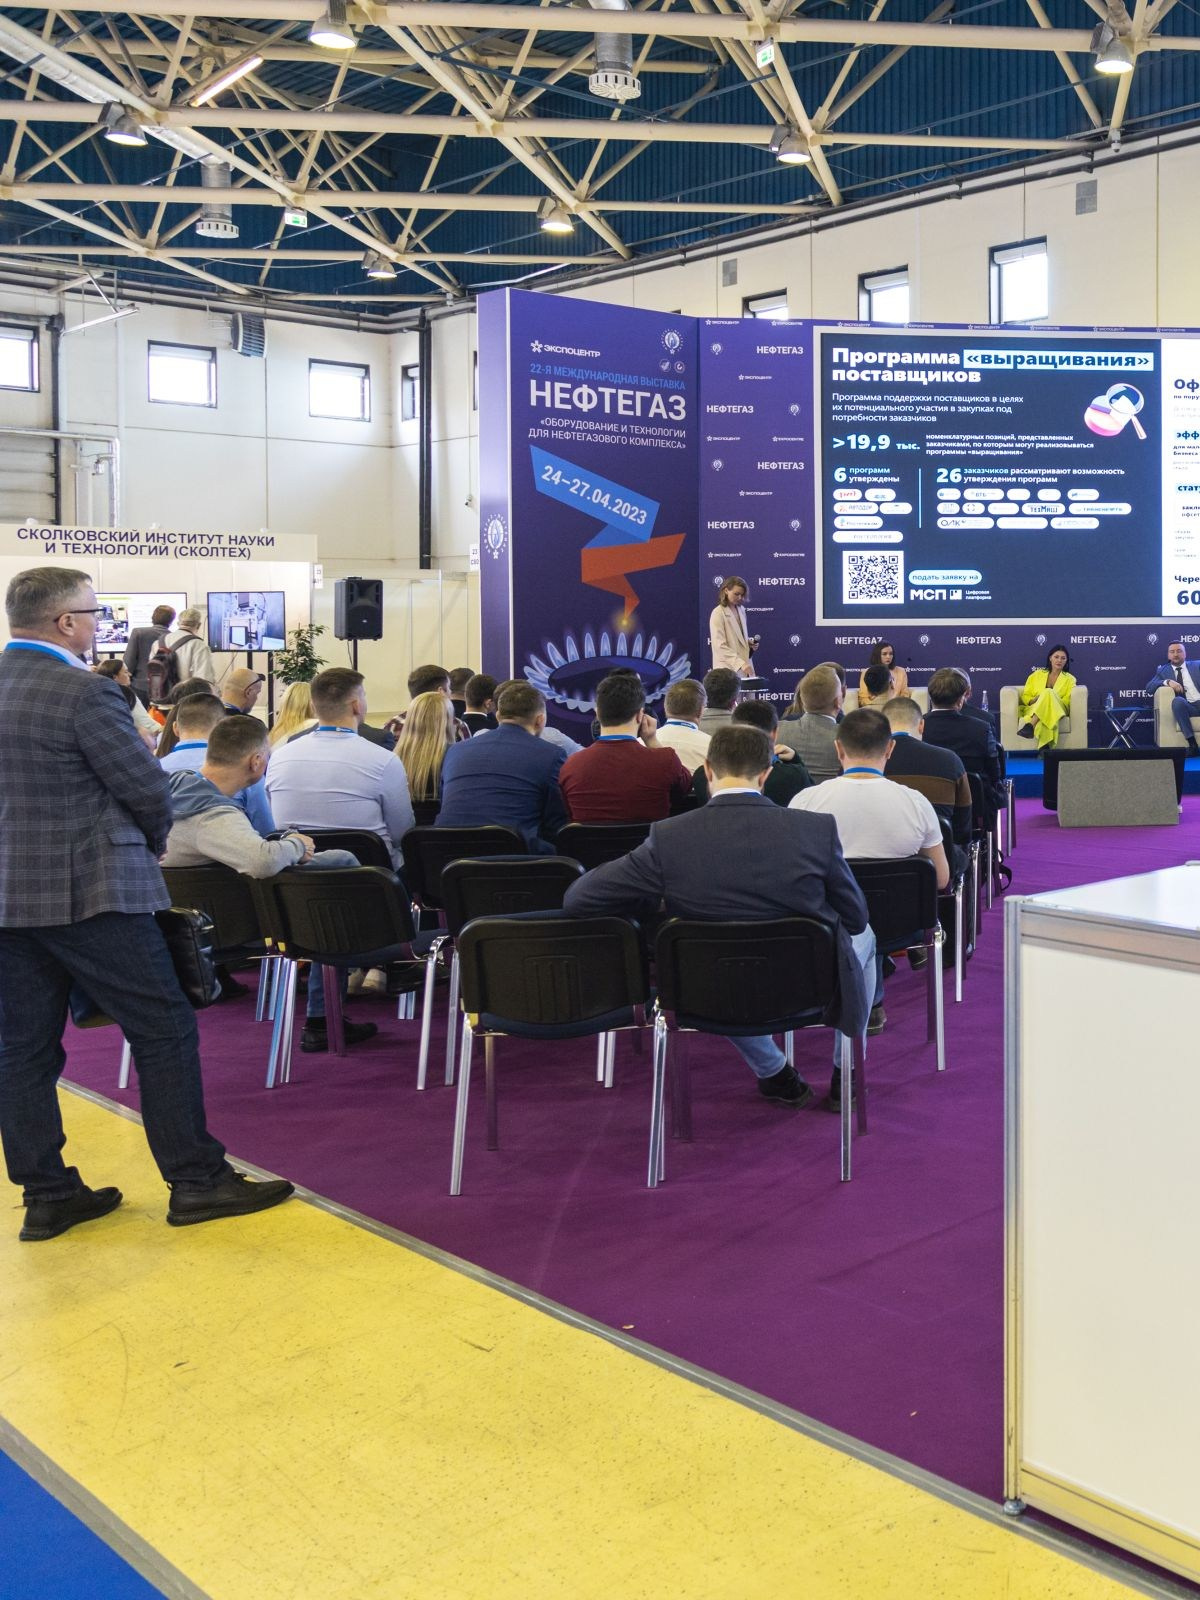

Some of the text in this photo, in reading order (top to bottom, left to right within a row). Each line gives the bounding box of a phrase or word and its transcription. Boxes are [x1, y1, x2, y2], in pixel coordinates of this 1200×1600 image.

[544, 344, 601, 358] ЭКСПОЦЕНТР
[757, 346, 804, 355] НЕФТЕГАЗ
[832, 348, 1149, 370] Программа «выращивания»
[530, 363, 686, 390] 22-Я МЕЖДУНАРОДНАЯ ВЫСТАВКА
[832, 369, 982, 386] поставщиков
[530, 379, 687, 421] НЕФТЕГАЗ
[832, 392, 882, 403] Программа
[884, 394, 932, 403] поддержки
[934, 395, 990, 403] поставщиков
[998, 396, 1024, 404] целях
[706, 405, 754, 414] НЕФТЕГАЗ
[844, 404, 914, 413] потенциального
[916, 405, 949, 414] участия
[957, 406, 994, 414] закупках
[996, 406, 1012, 414] под
[832, 413, 888, 423] потребности
[540, 417, 686, 438] «ОБОРУДОВАНИЕ И ТЕХНОЛОГИИ
[528, 428, 686, 449] ДЛЯ НЕФТЕГАЗОВОГО КОМПЛЕКСА»
[985, 433, 1017, 442] позиций,
[1018, 434, 1074, 442] представленных
[1015, 442, 1034, 450] могут
[1035, 442, 1094, 450] реализовываться
[968, 449, 1024, 457] «выращивания»
[757, 461, 805, 470] НЕФТЕГАЗ
[834, 467, 890, 483] 6 программ
[849, 476, 900, 484] утверждены
[936, 468, 962, 483] 26
[1010, 468, 1072, 476] рассматривают
[963, 476, 1058, 484] утверждения программ
[541, 465, 648, 526] 24–27.04.2023
[707, 521, 755, 529] НЕФТЕГАЗ
[17, 528, 275, 547] СКОЛКОВСКИЙ ИНСТИТУТ НАУКИ
[45, 542, 56, 554] И
[174, 545, 251, 560] (СКОЛТЕХ)
[758, 577, 806, 586] НЕФТЕГАЗ
[910, 589, 947, 601] МСП
[956, 636, 1002, 645] НЕФТЕГАЗ
[1070, 635, 1117, 644] NEFTEGAZ
